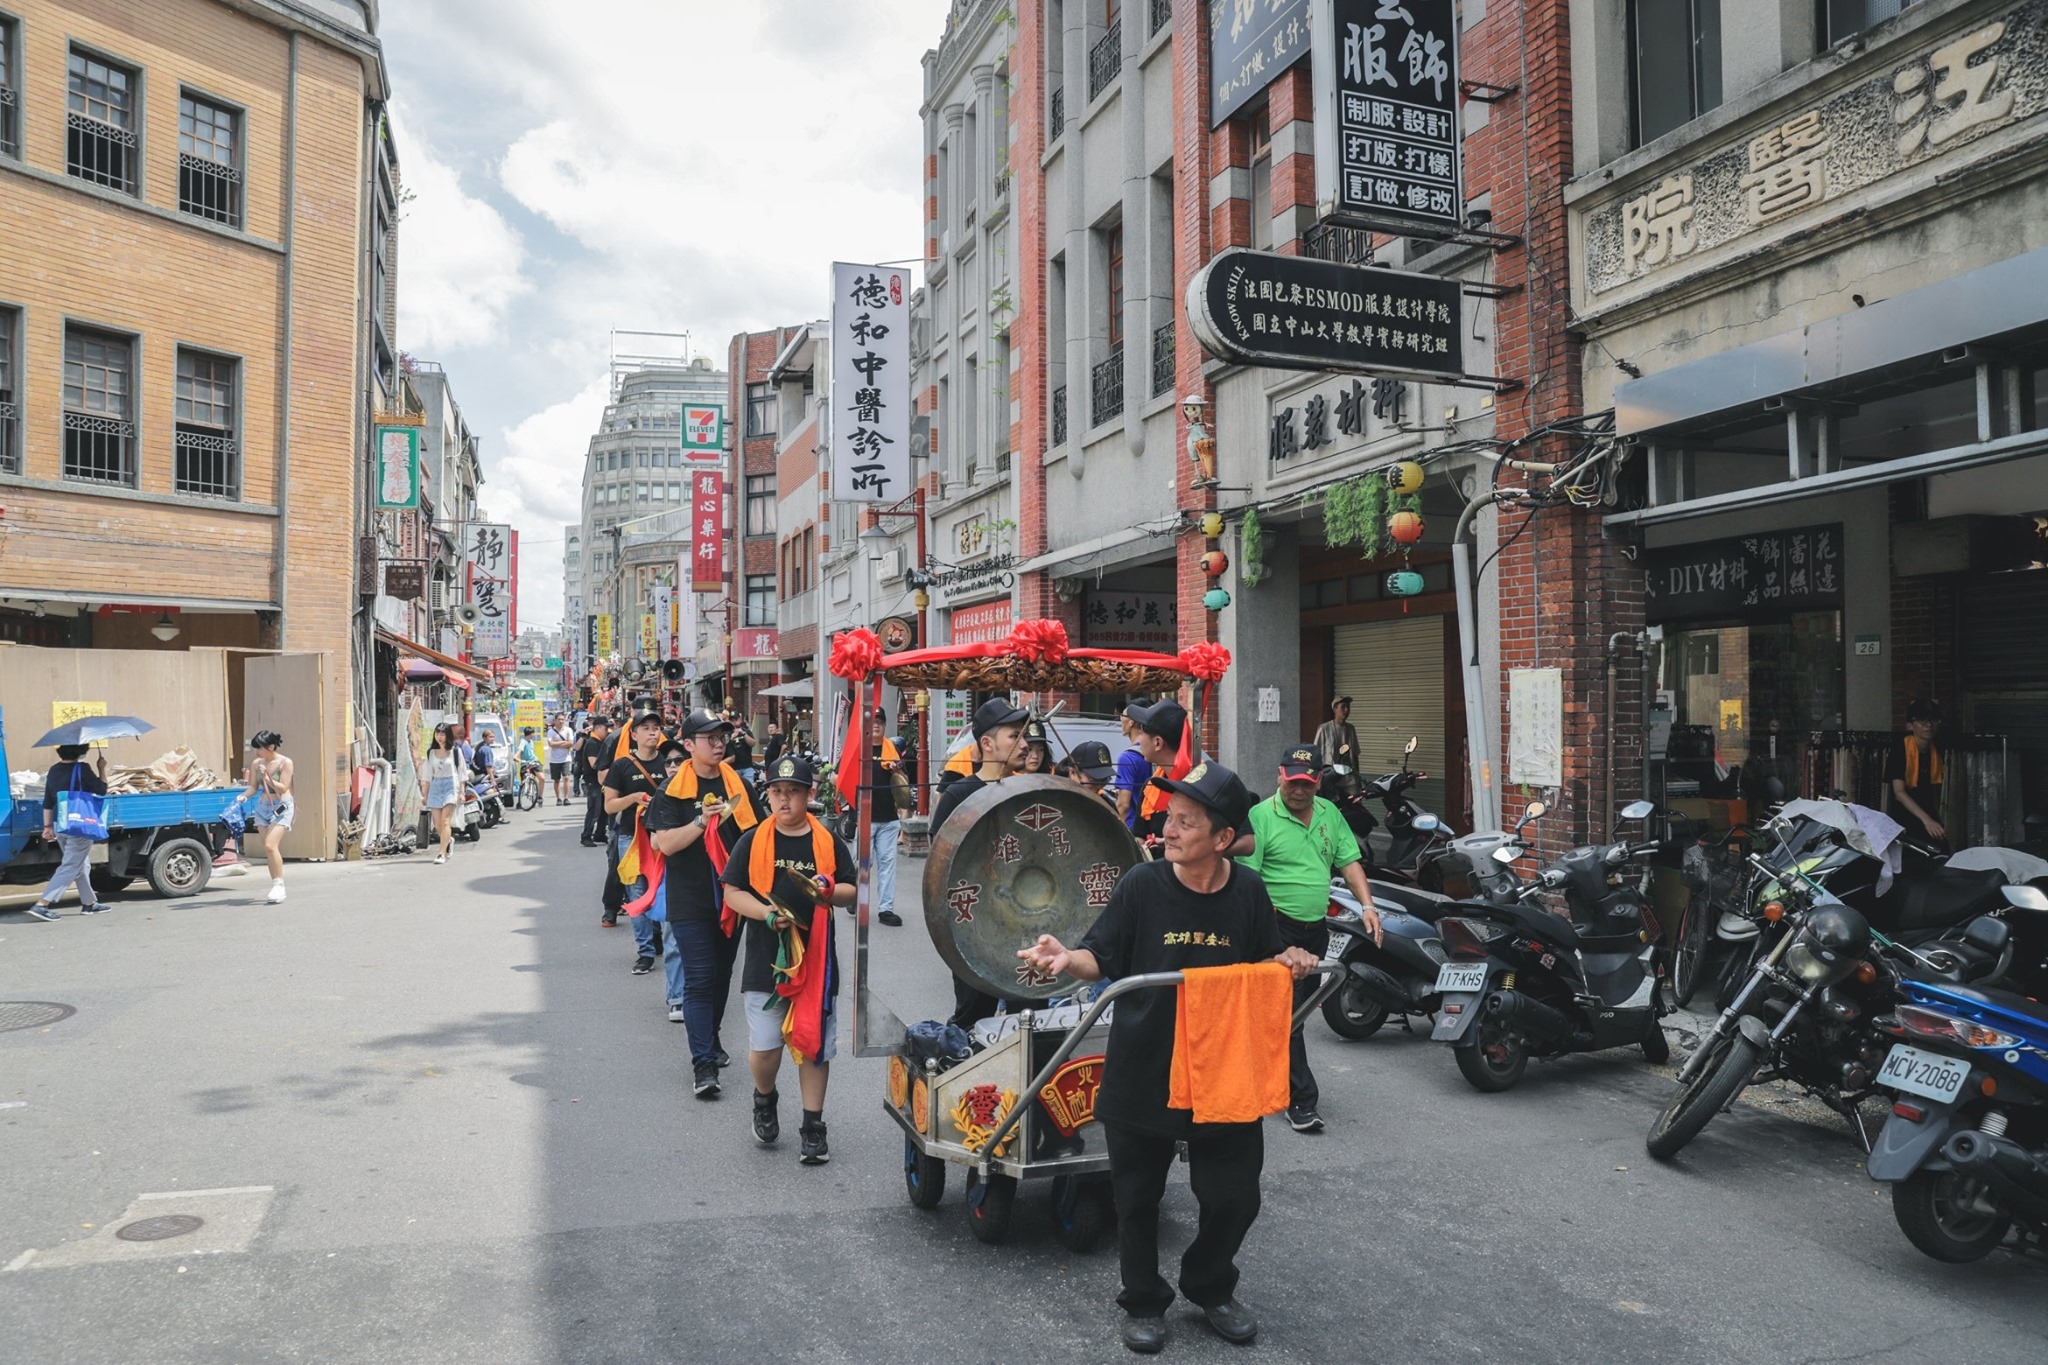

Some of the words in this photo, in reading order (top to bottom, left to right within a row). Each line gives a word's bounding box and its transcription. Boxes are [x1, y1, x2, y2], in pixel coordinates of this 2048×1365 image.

[1344, 22, 1448, 102] 服飾
[1226, 265, 1246, 301] SKILL
[1227, 302, 1250, 341] KNOW
[847, 273, 894, 498] 德和中醫診所
[1269, 378, 1406, 460] 服裝材料
[699, 476, 717, 560] 龍心藥行
[1789, 534, 1809, 595] 蕾絲
[1816, 531, 1838, 593] 花邊
[1860, 643, 1875, 653] 26
[947, 880, 982, 924] 安
